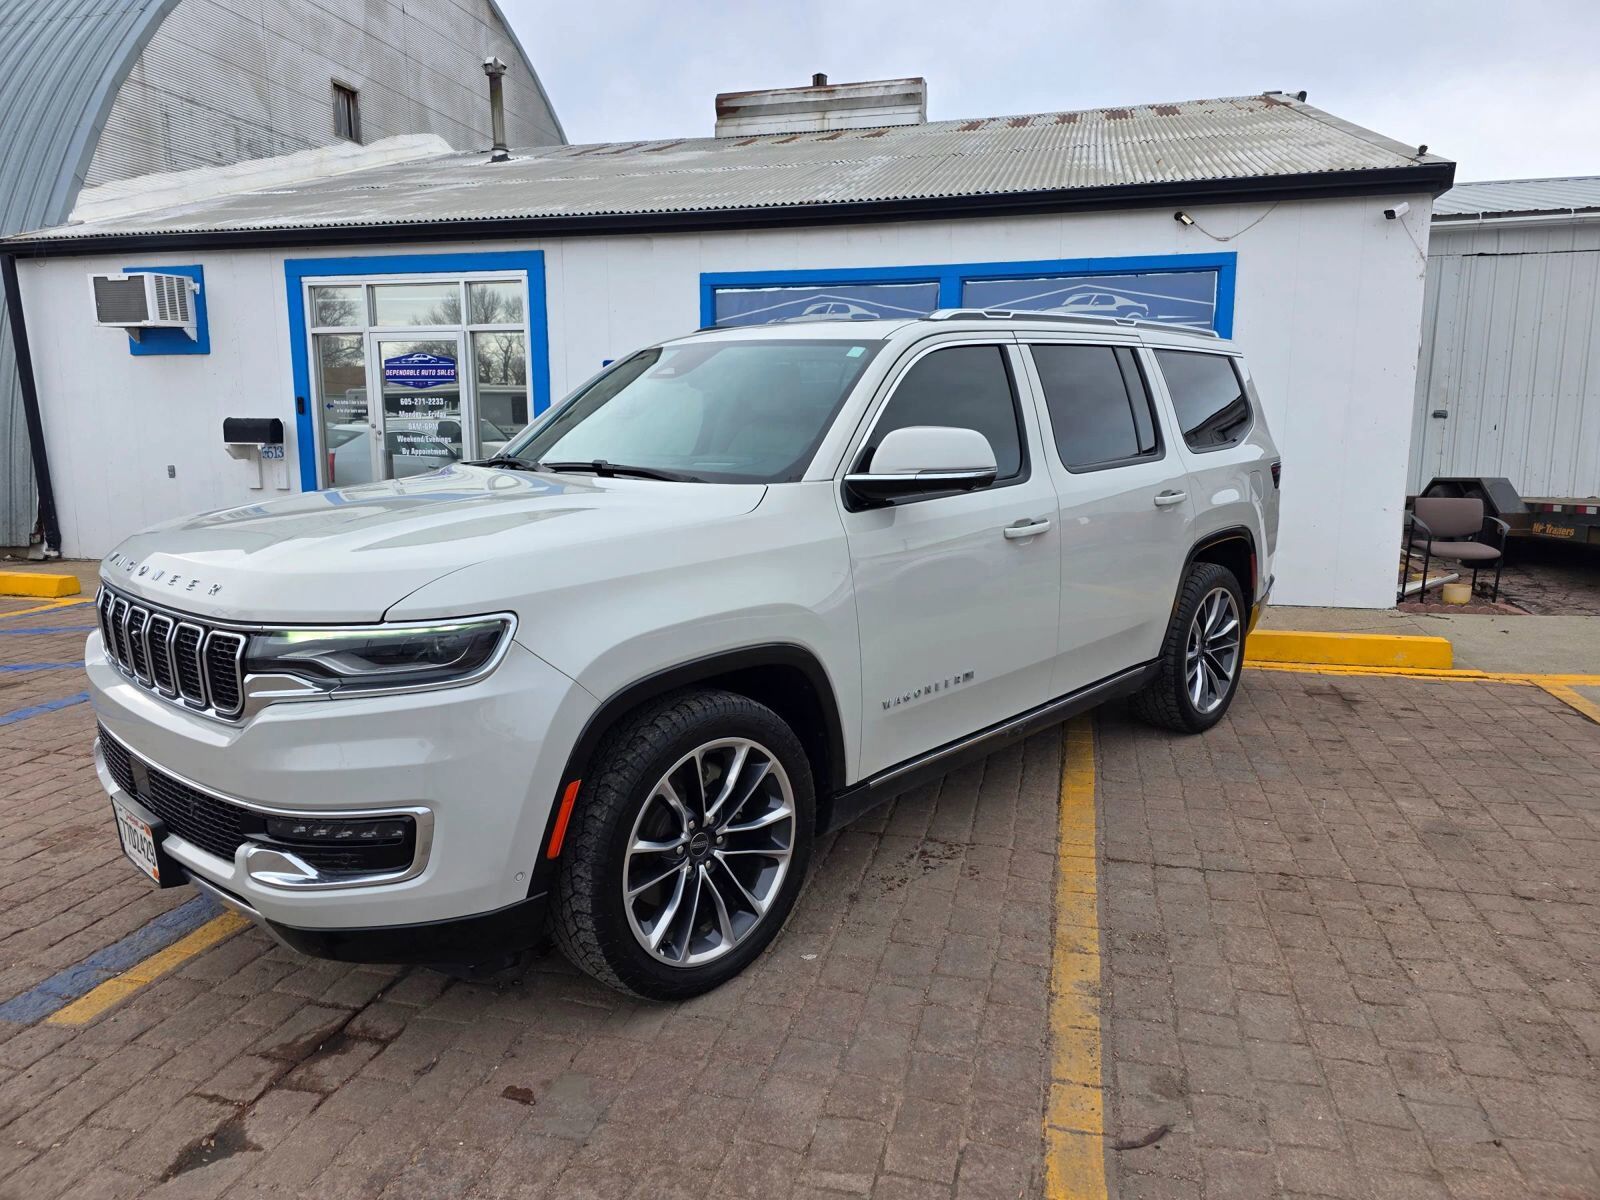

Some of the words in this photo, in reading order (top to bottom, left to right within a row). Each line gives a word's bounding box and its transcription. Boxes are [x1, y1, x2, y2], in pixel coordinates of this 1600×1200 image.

[400, 398, 444, 406] 605-271-2233
[399, 410, 422, 419] Monday
[428, 410, 447, 419] Friday
[401, 447, 410, 456] By
[411, 447, 449, 456] Appointment
